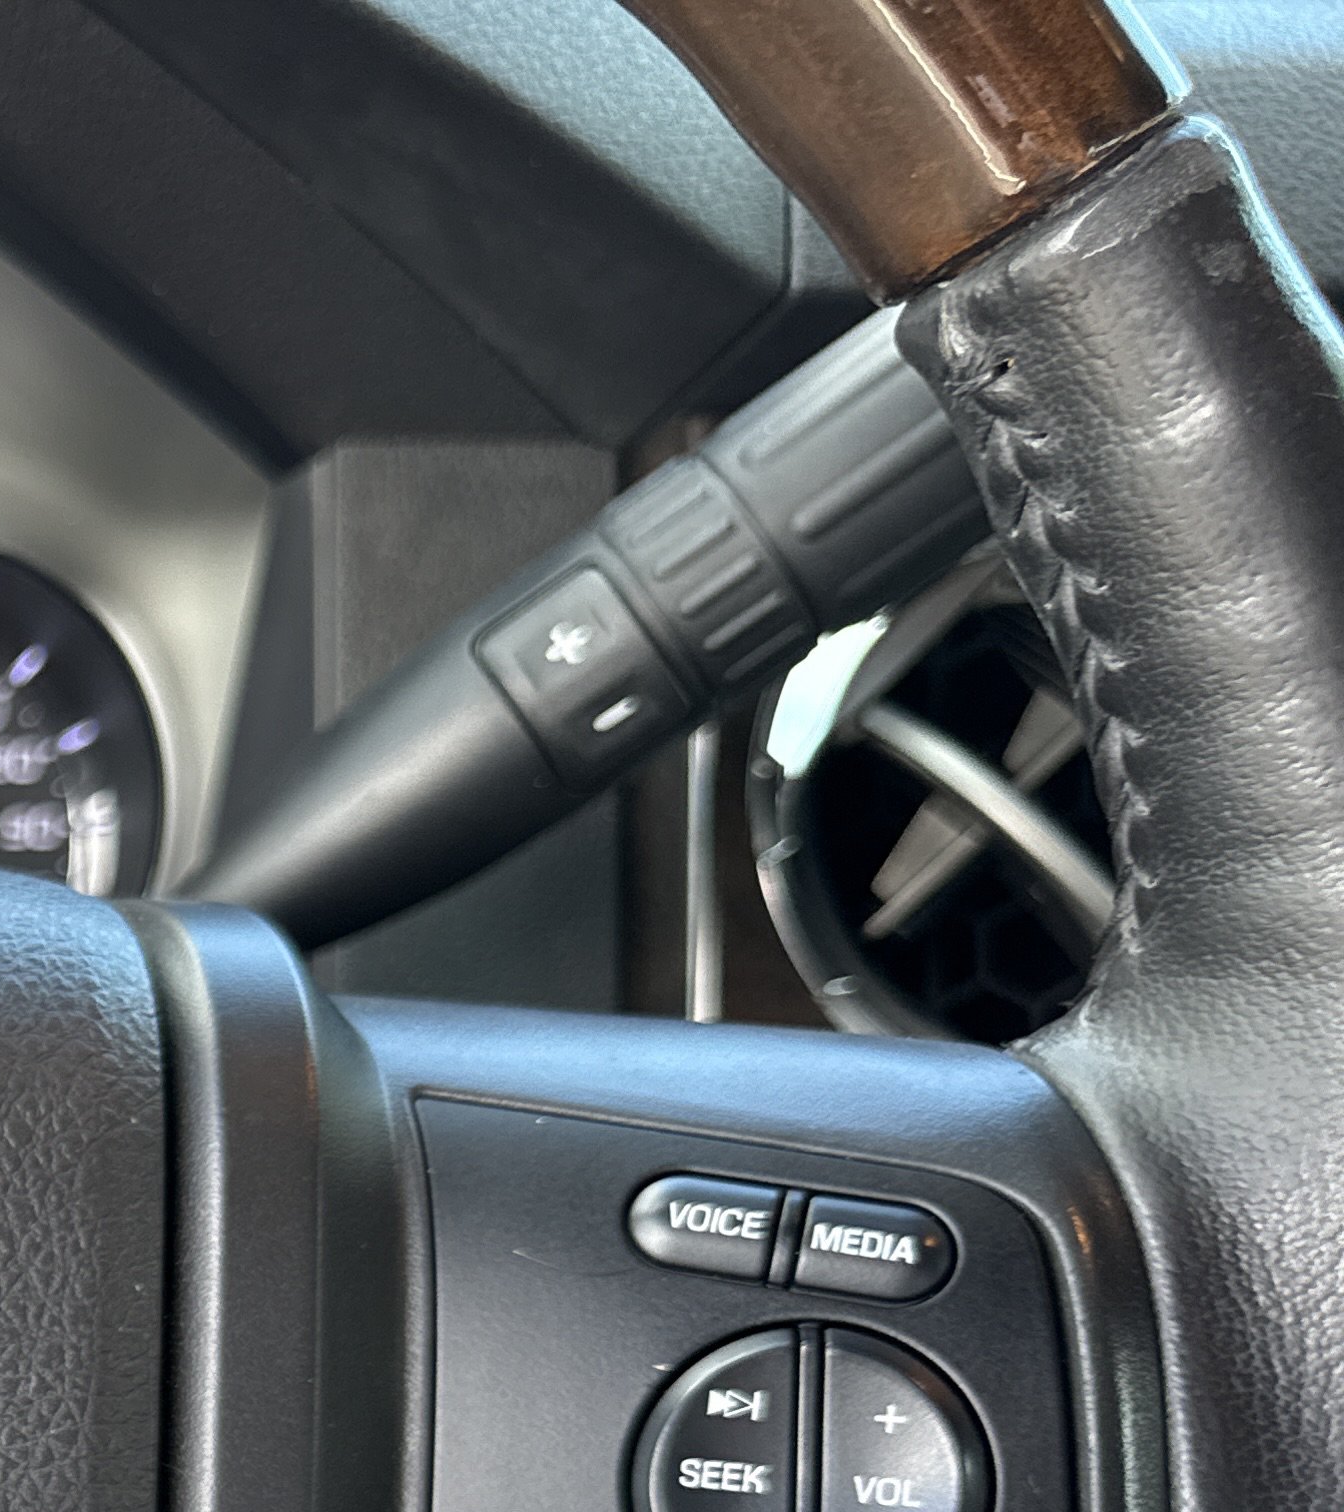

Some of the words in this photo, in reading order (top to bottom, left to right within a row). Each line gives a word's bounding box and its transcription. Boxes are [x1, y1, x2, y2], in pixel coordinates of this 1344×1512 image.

[668, 1202, 770, 1241] VOICE
[810, 1223, 919, 1265] MEDIA
[677, 1457, 771, 1495] SEEK
[852, 1475, 921, 1508] VOL
